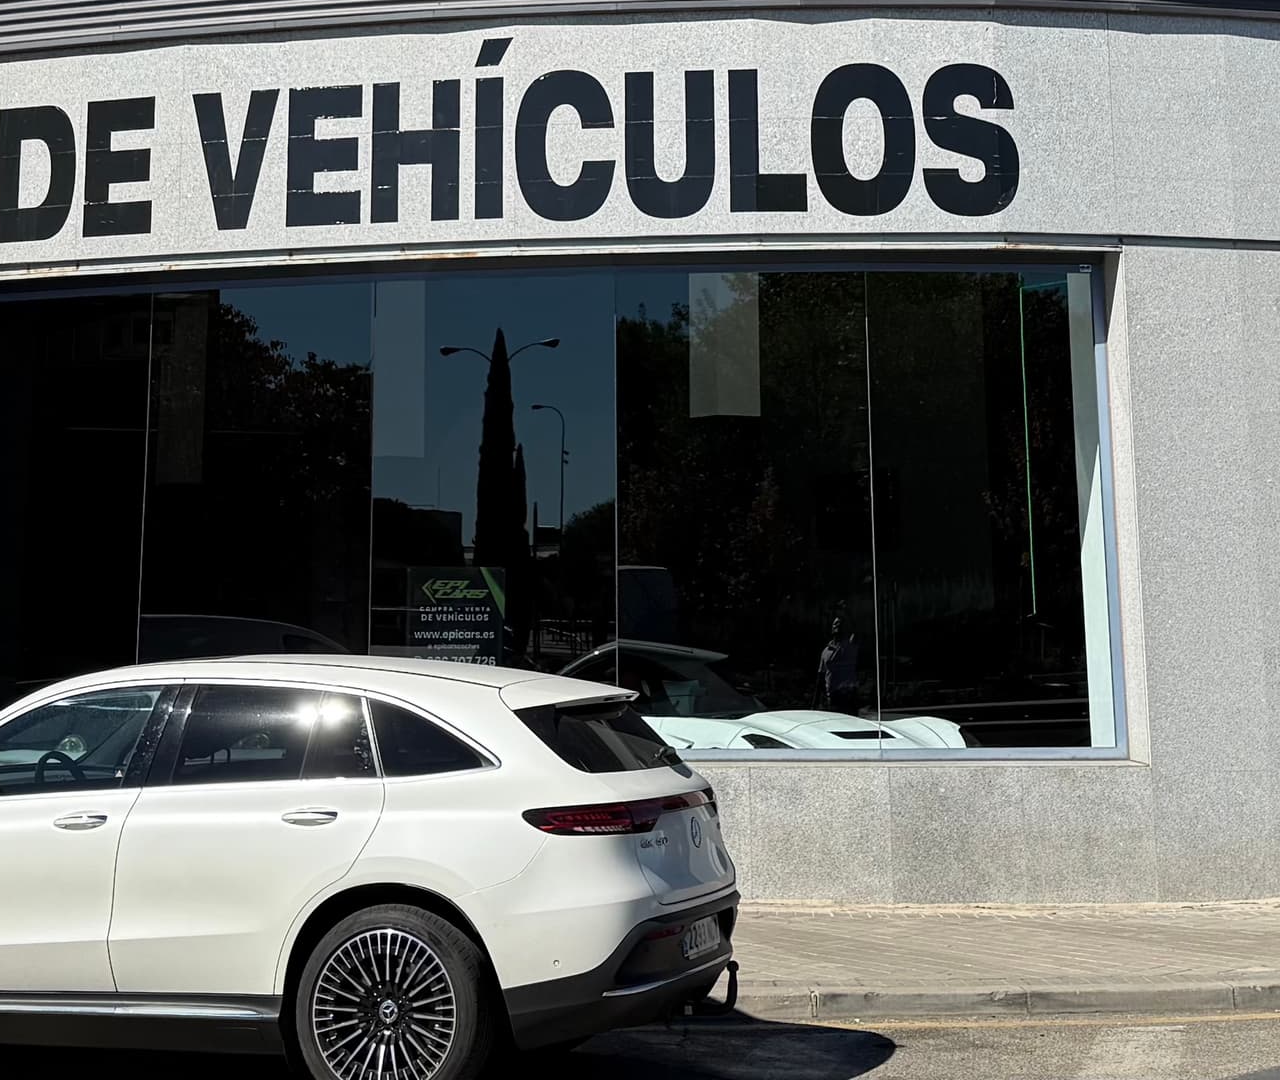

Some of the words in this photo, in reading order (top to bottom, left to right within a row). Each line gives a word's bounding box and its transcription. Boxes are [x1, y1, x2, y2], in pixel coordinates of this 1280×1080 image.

[193, 37, 1021, 230] VEHÍCULOS
[431, 579, 471, 589] EPI
[434, 589, 489, 599] CARS
[420, 613, 433, 622] DE
[435, 611, 489, 622] VEHÍCULOS
[414, 629, 495, 640] www.epicars.es
